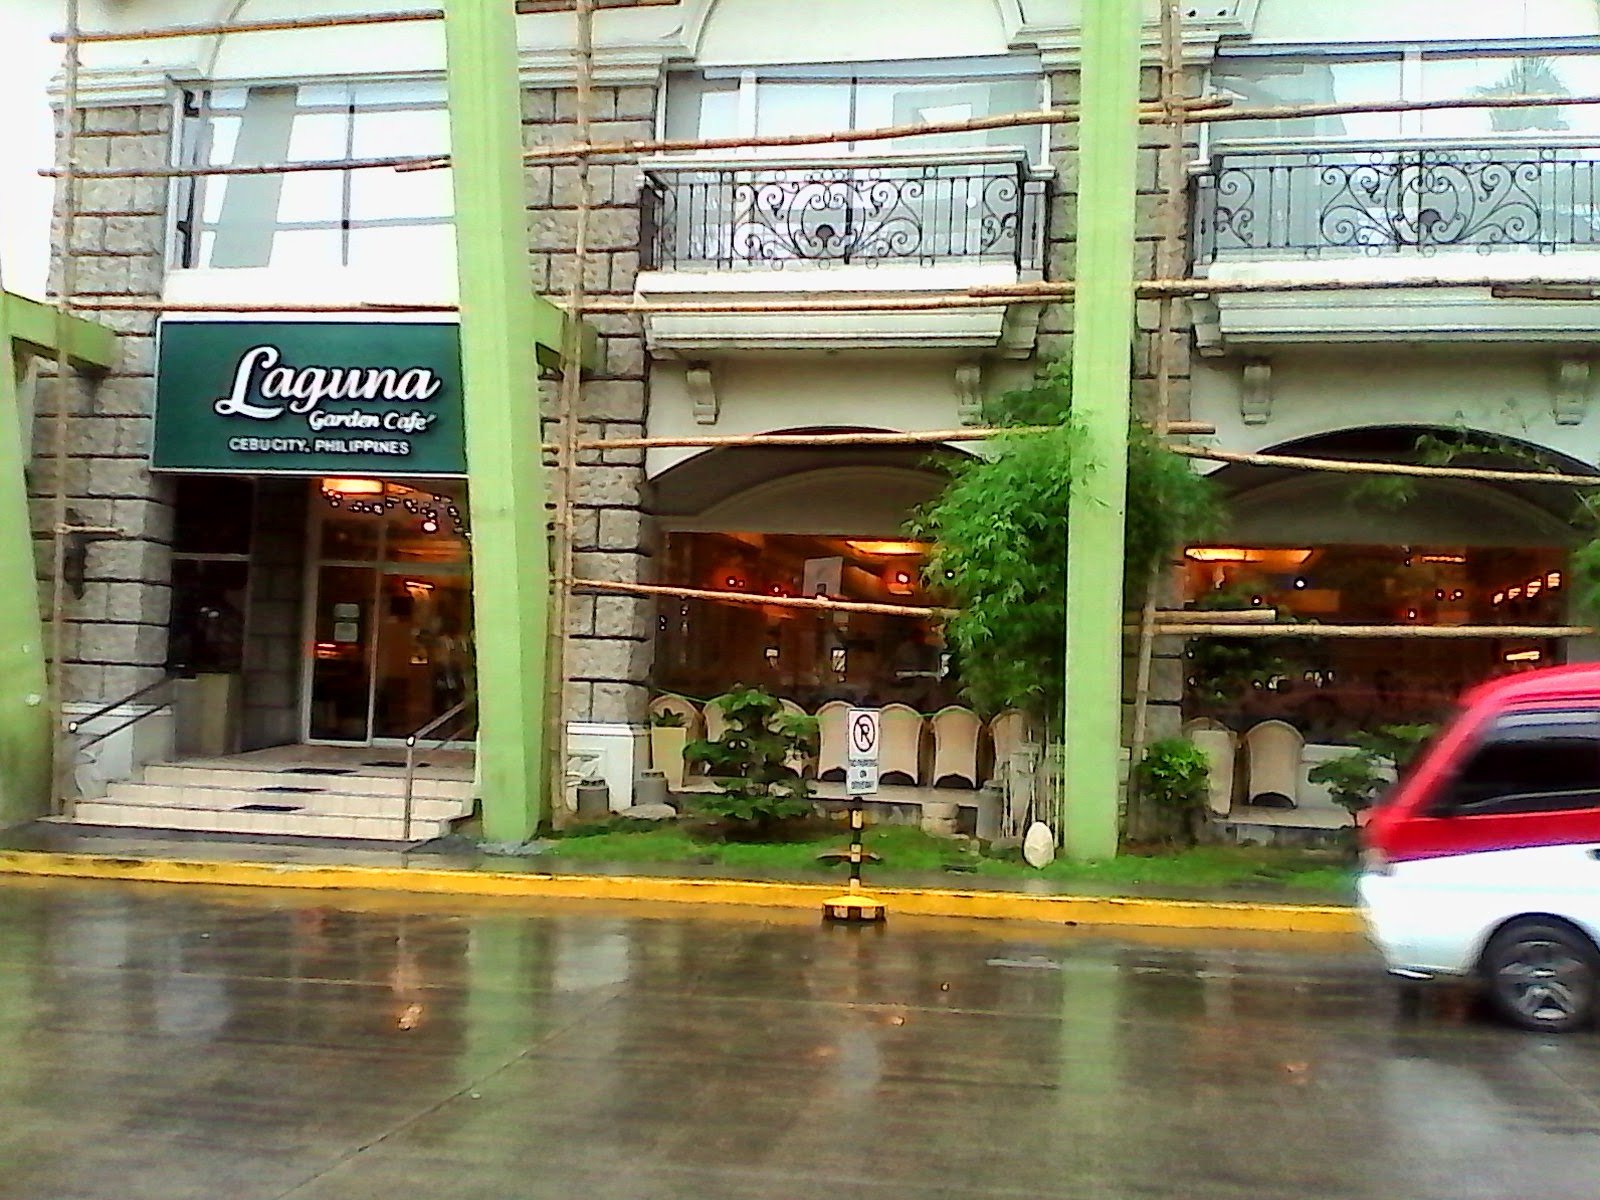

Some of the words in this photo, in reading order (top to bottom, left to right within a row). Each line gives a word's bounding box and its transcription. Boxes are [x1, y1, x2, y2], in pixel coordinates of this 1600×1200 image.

[214, 345, 441, 419] Laguna
[309, 410, 380, 430] Garden
[314, 439, 410, 455] PHILIPPINES
